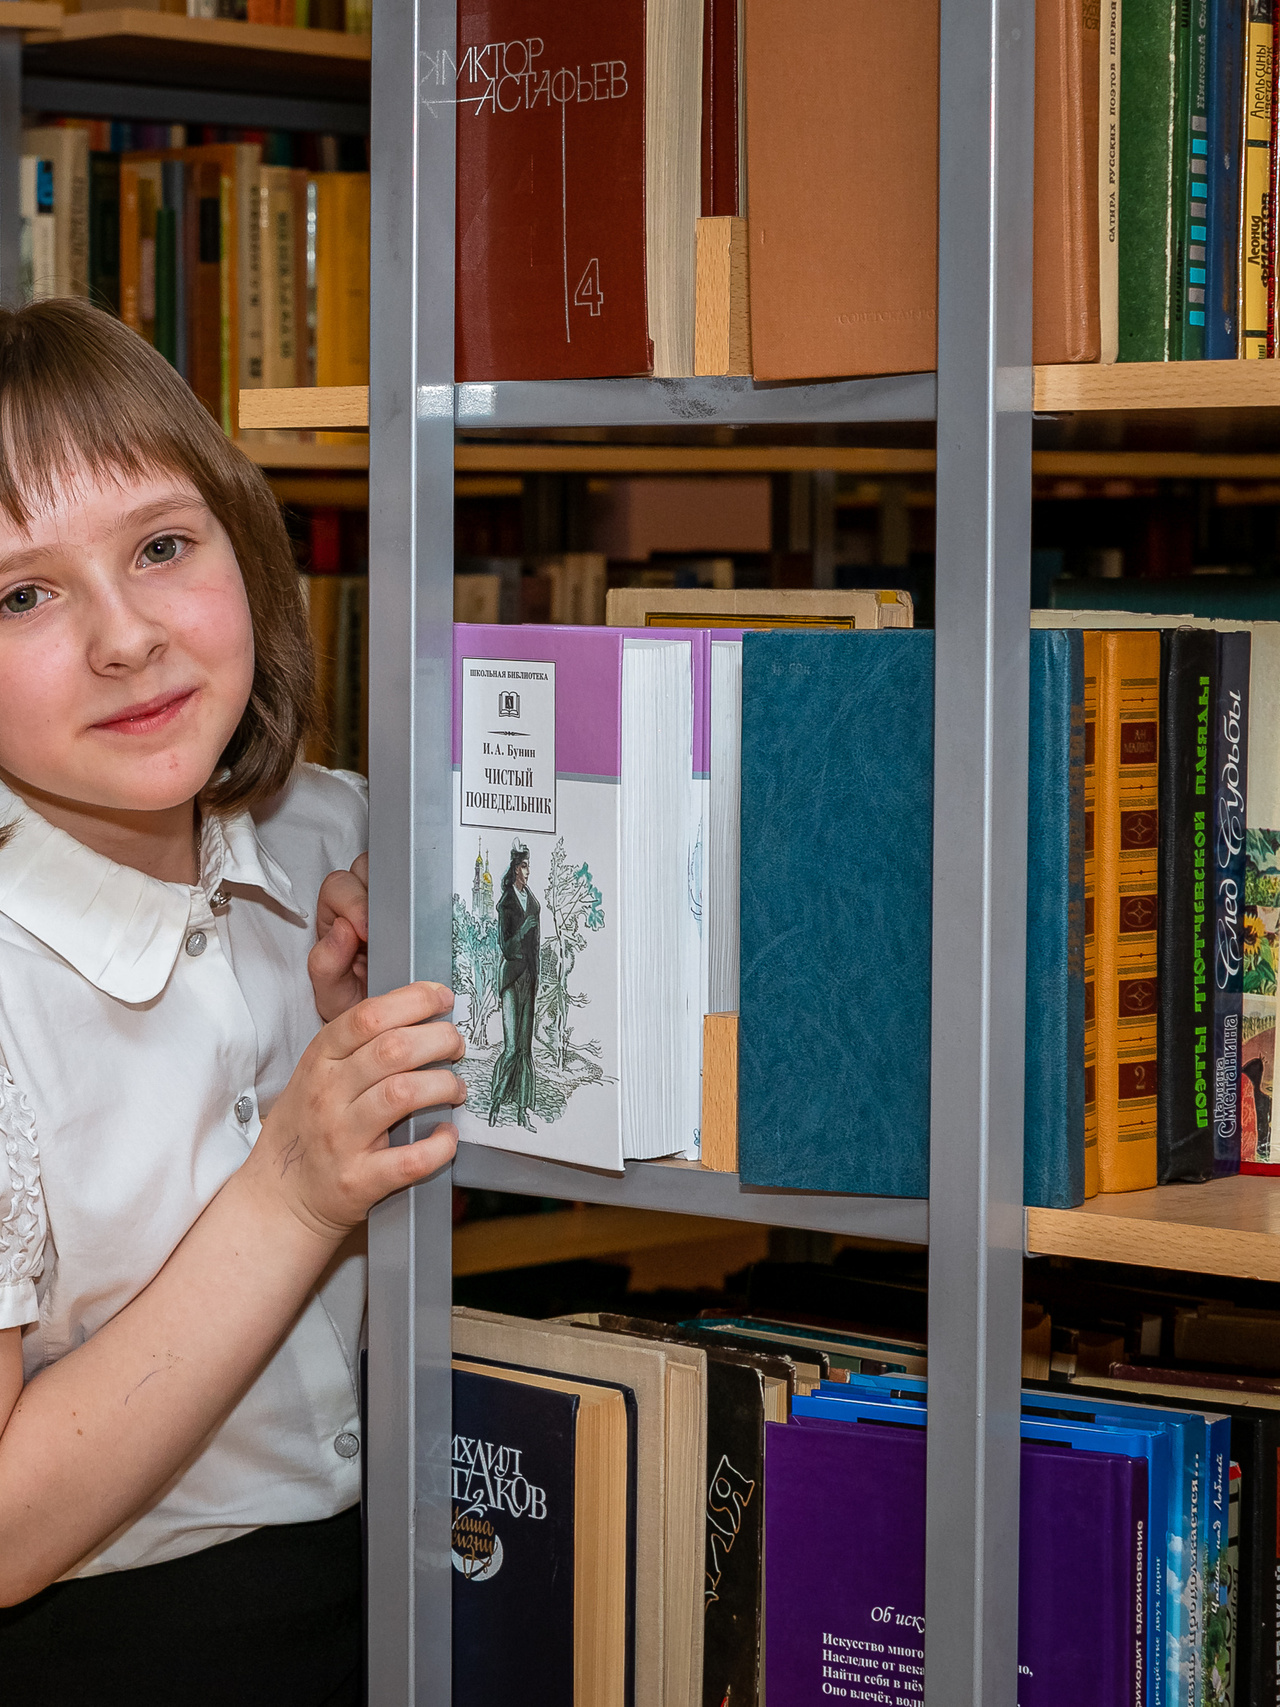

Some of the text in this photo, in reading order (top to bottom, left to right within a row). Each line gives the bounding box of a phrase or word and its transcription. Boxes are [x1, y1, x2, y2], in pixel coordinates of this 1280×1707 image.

[456, 37, 544, 83] ИКТОР
[1196, 34, 1207, 109] Николай
[1250, 44, 1267, 119] Апельсины
[474, 59, 629, 117] АСТАФЬЕВ
[1109, 63, 1118, 116] ПОЭТОВ
[1108, 123, 1117, 184] РУССКИХ
[1108, 190, 1117, 242] САТИРА
[1247, 215, 1264, 266] Леонид
[574, 258, 604, 317] 4
[469, 668, 549, 681] ШКОЛЬНАЯ БИБЛИОТЕКА
[484, 767, 534, 788] ЧИСТЫЙ
[507, 744, 536, 760] Бунин
[465, 791, 552, 815] ПОНЕДЕЛЬНИК
[1216, 688, 1244, 990] След Судьбы
[1193, 675, 1210, 1129] ПОЭТЫ ТЮТЧЕВСКОЙ ПЛЕЯДЫ
[1134, 1065, 1145, 1090] 2
[1215, 1056, 1225, 1123] Галина
[1218, 1013, 1239, 1138] Сметанина
[1212, 1518, 1222, 1551] над
[1154, 1556, 1162, 1596] дорог
[1187, 1452, 1201, 1707] изнь продолжается...
[1210, 1559, 1222, 1615] Чайки
[870, 1605, 895, 1623] Об
[1135, 1520, 1145, 1707] риходит вдохновение
[822, 1632, 885, 1654] Искусство
[822, 1649, 879, 1670] Наследие
[881, 1659, 896, 1671] от
[821, 1682, 847, 1698] Оно
[850, 1688, 893, 1706] влечёт,
[822, 1665, 861, 1682] Найти
[864, 1673, 890, 1688] себя
[893, 1677, 901, 1689] в
[1153, 1636, 1162, 1706] рекрёстке
